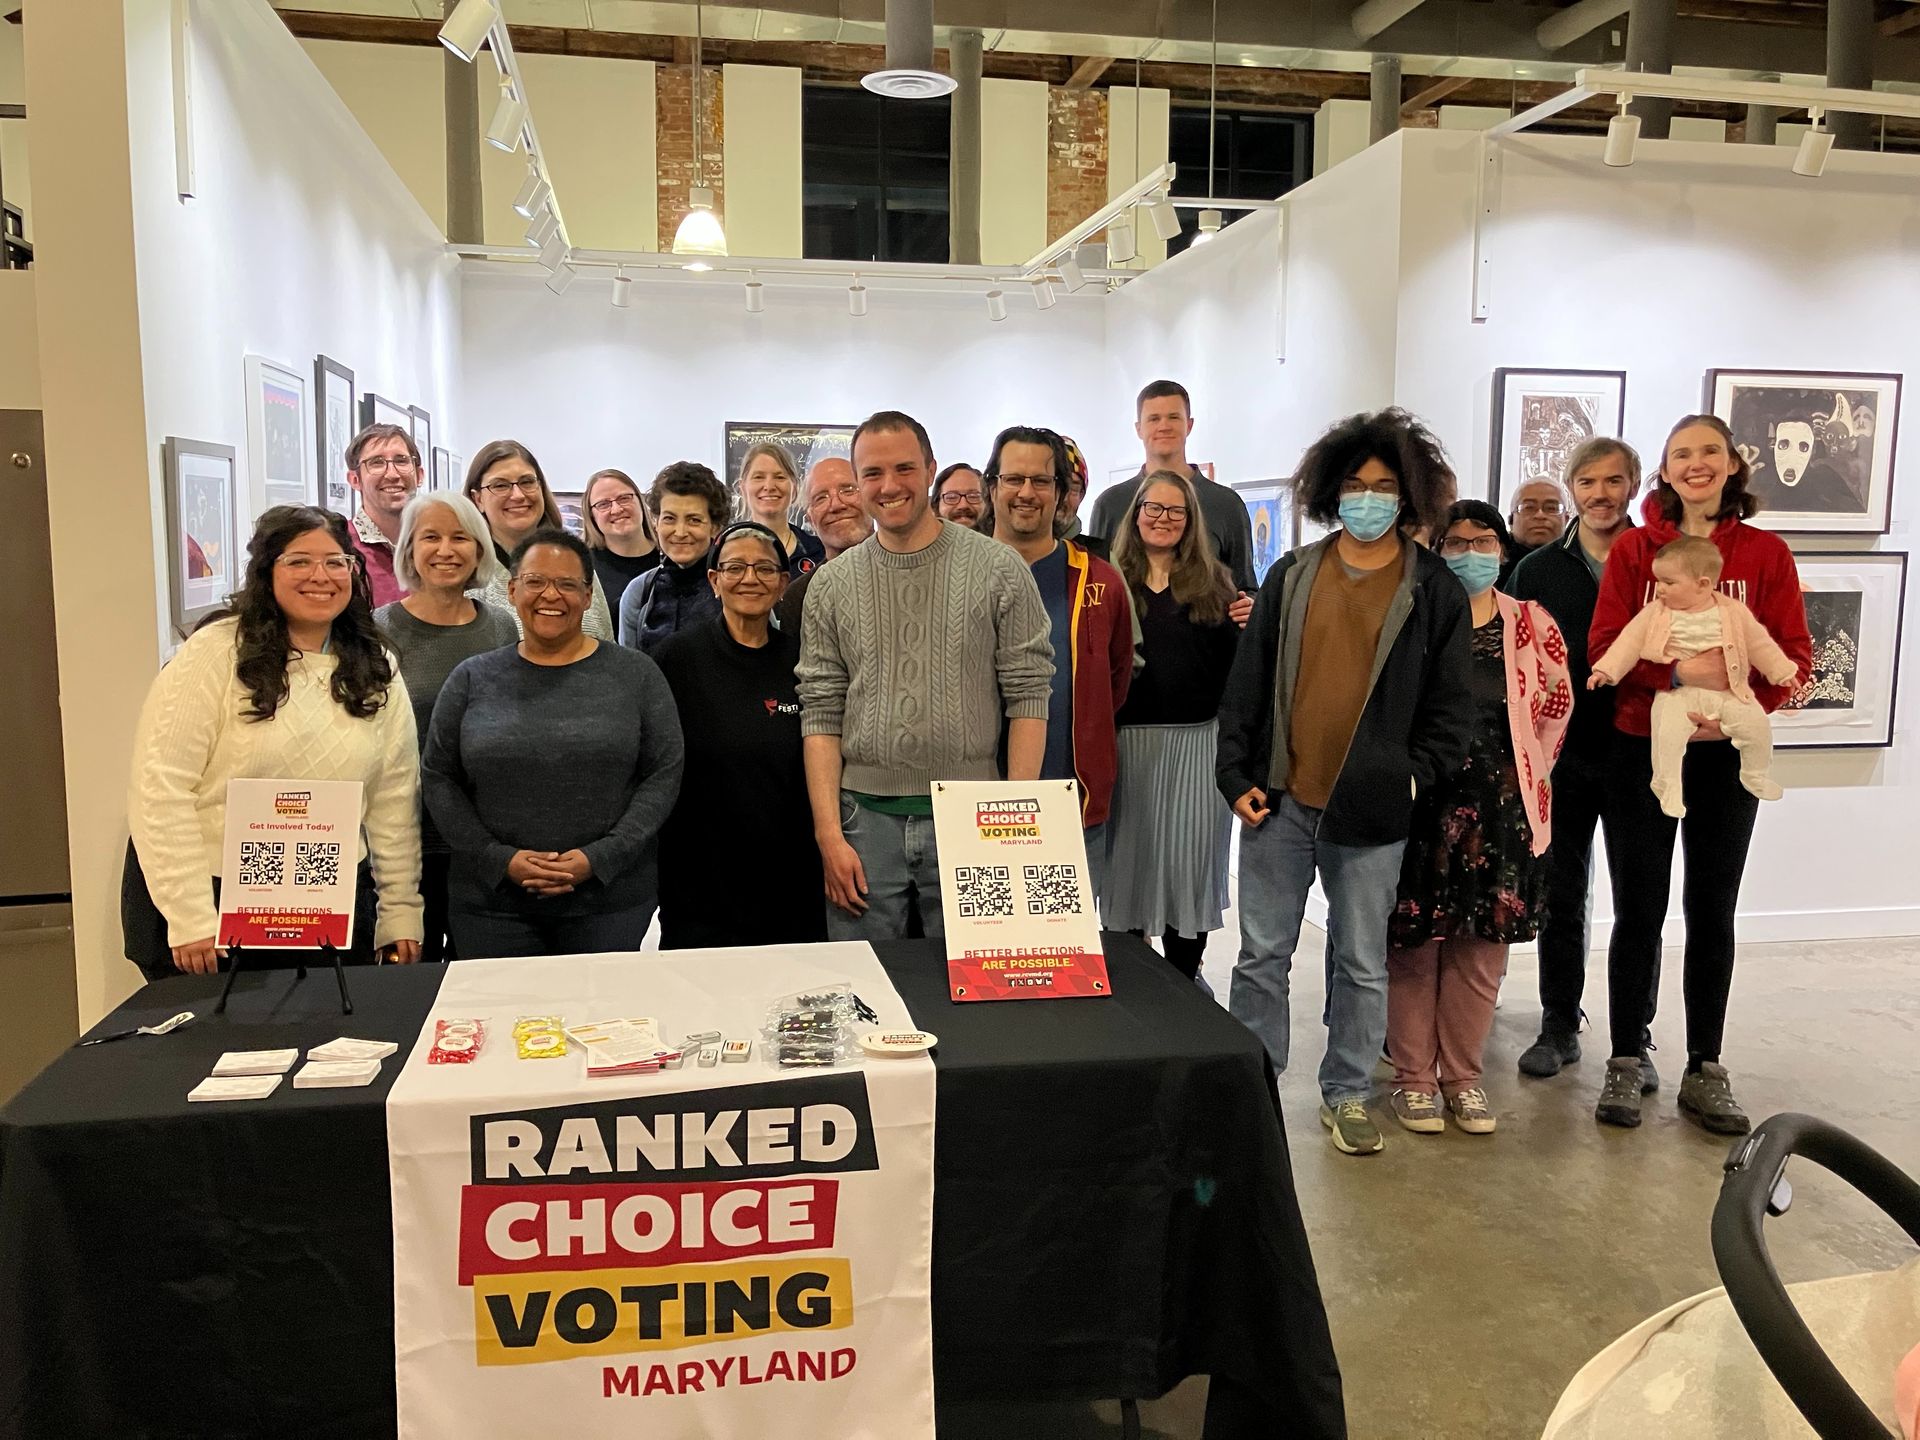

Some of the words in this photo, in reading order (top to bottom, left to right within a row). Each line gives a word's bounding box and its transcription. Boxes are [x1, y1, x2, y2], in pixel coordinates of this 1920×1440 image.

[978, 802, 1038, 812] RANKED
[980, 814, 1033, 824] CHOICE
[306, 823, 334, 832] Today!
[981, 828, 1037, 837] VOTING
[237, 906, 275, 914] BETTER
[279, 907, 332, 915] ELECTIONS
[248, 916, 269, 924] ARE
[271, 916, 321, 925] POSSIBLE.
[964, 948, 1012, 959] BETTER
[1016, 946, 1085, 957] ELECTIONS
[981, 960, 1007, 970] ARE
[1010, 958, 1074, 969] POSSIBLE.
[484, 1103, 857, 1180] RANKED
[485, 1185, 815, 1261] CHOICE
[485, 1272, 832, 1348] VOTING
[602, 1347, 857, 1398] MARYLAND
